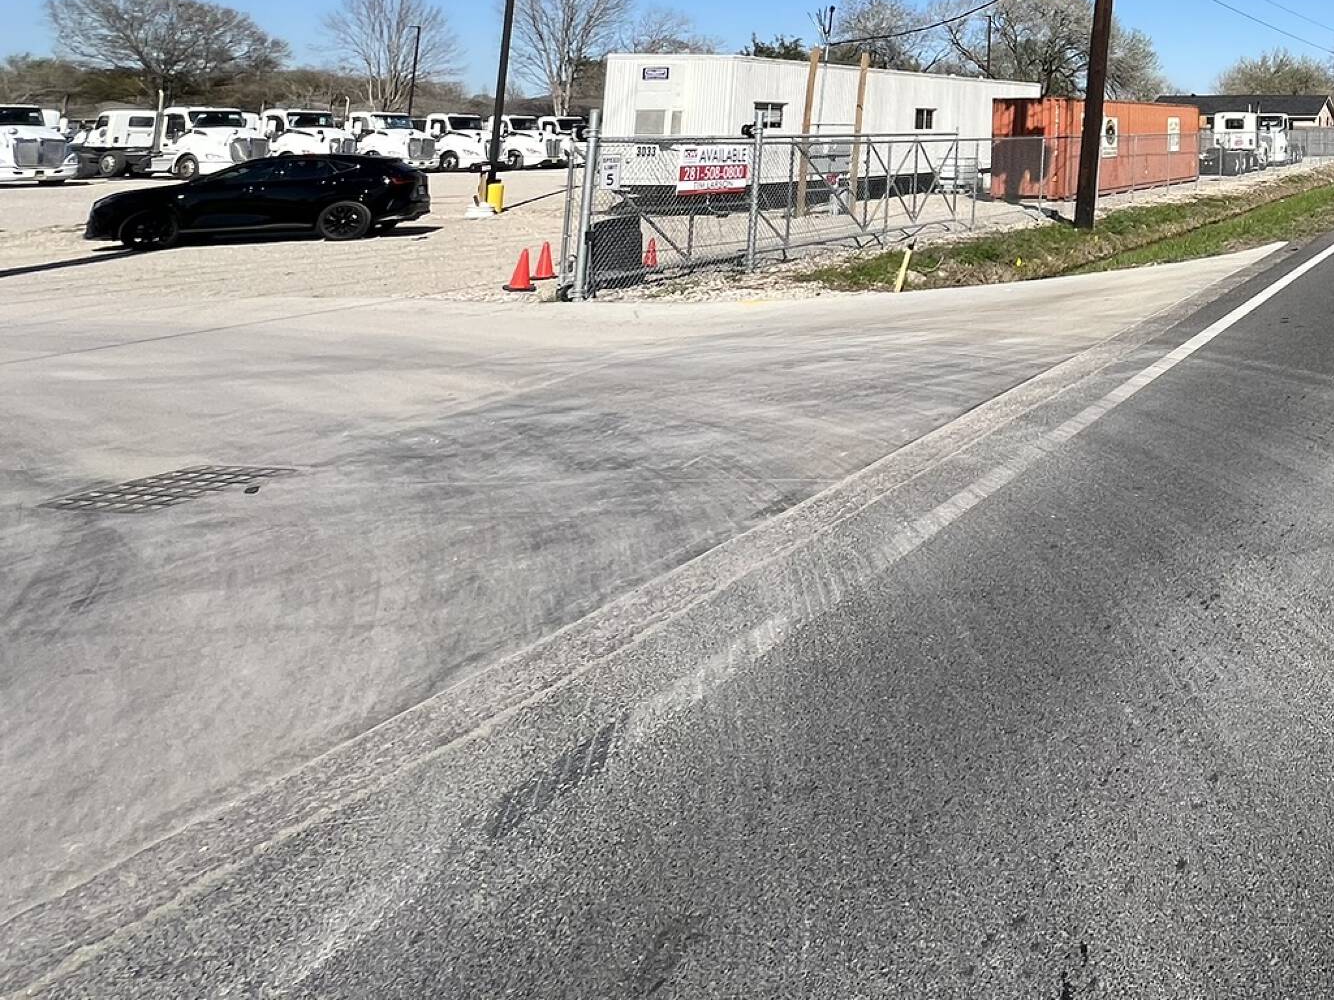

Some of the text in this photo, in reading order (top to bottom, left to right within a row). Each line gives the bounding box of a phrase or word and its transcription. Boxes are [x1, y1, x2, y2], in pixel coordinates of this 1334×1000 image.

[637, 146, 656, 157] 3033
[699, 147, 747, 163] AVAILABLE
[606, 173, 614, 186] 5
[683, 165, 744, 181] 281-508-0800
